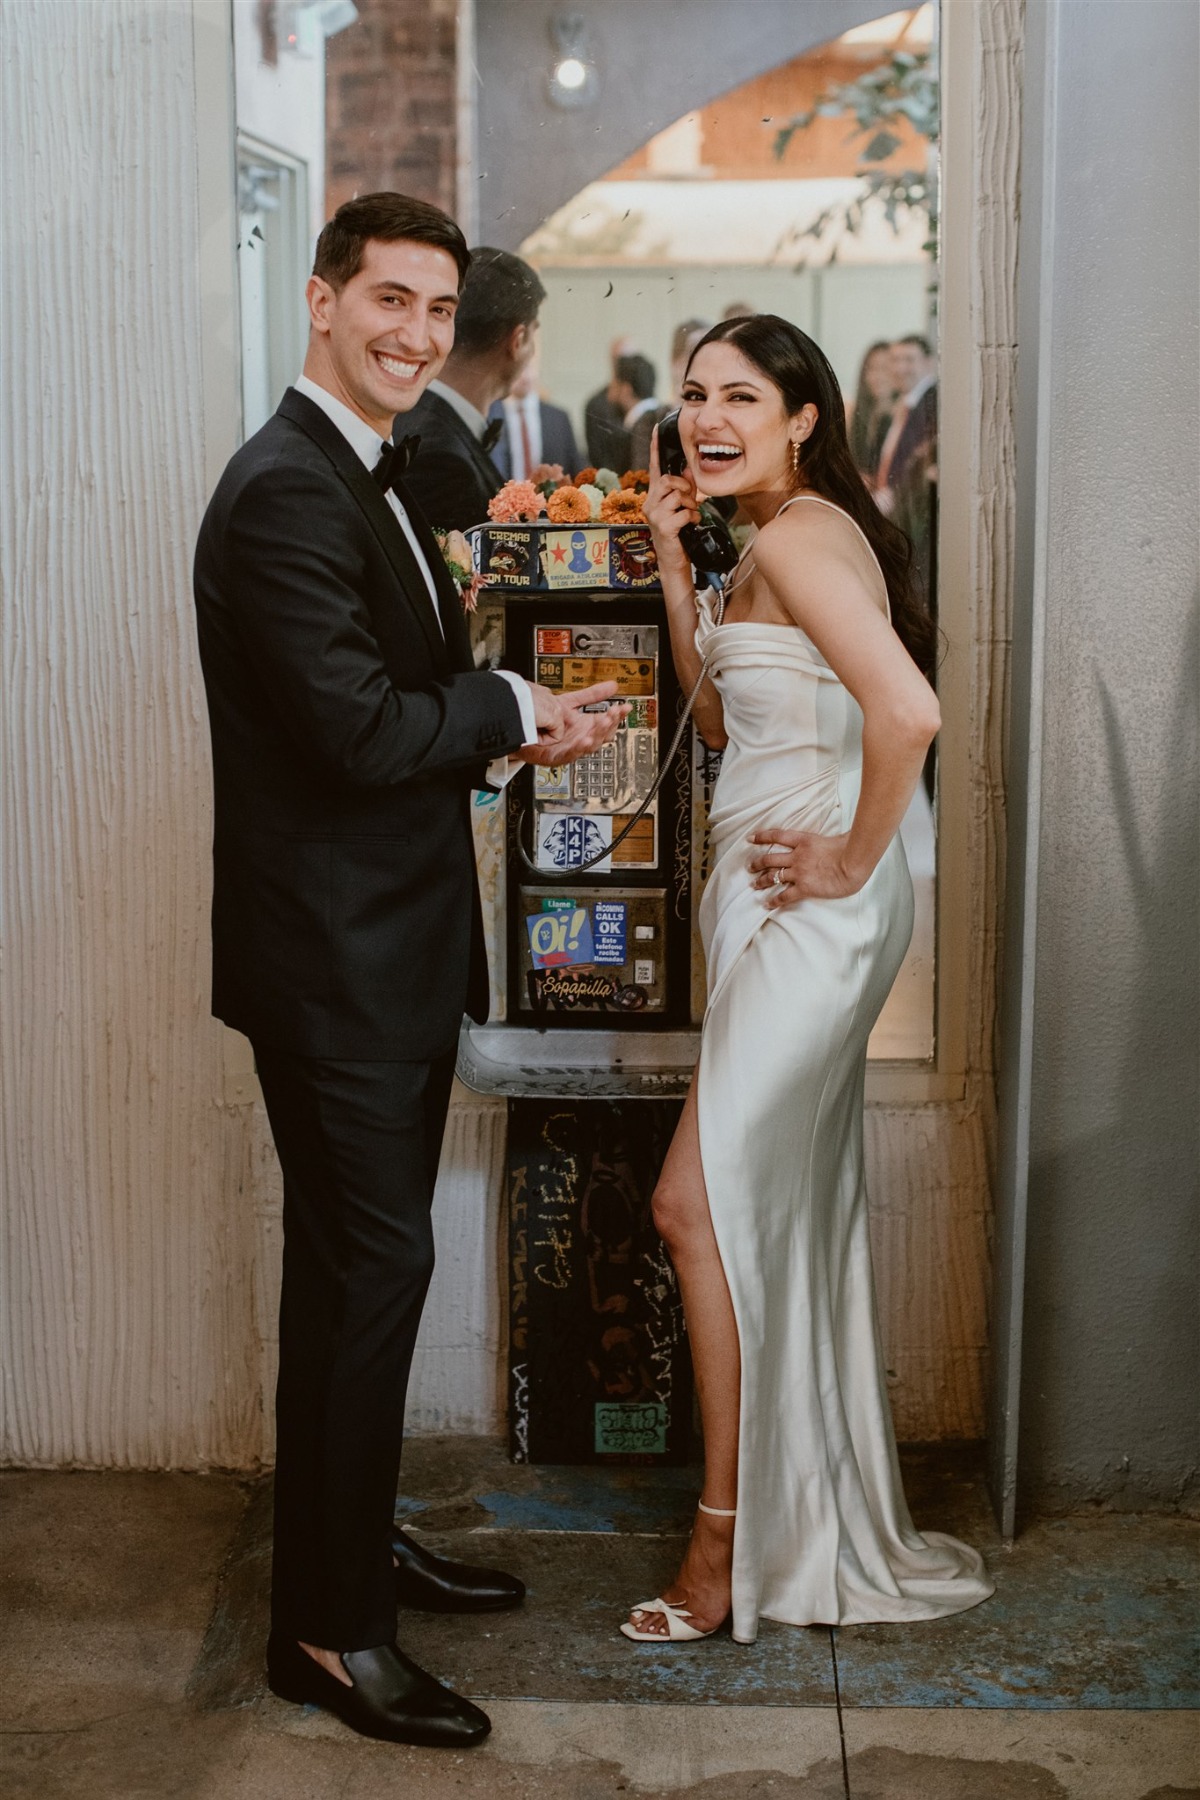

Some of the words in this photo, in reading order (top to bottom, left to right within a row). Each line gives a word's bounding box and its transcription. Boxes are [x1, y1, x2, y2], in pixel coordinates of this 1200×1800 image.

[488, 530, 531, 543] CREMAS
[592, 540, 609, 559] Oi!
[488, 573, 502, 584] ON
[503, 574, 531, 586] TOUR
[550, 573, 575, 581] BRIGADA
[616, 570, 630, 584] DEL
[540, 663, 561, 675] 50¢
[547, 900, 571, 908] Llame
[595, 913, 624, 921] CALLS
[531, 908, 586, 955] Oi!
[599, 922, 621, 934] OK
[595, 944, 624, 952] telefono
[542, 977, 613, 998] Sopapilla
